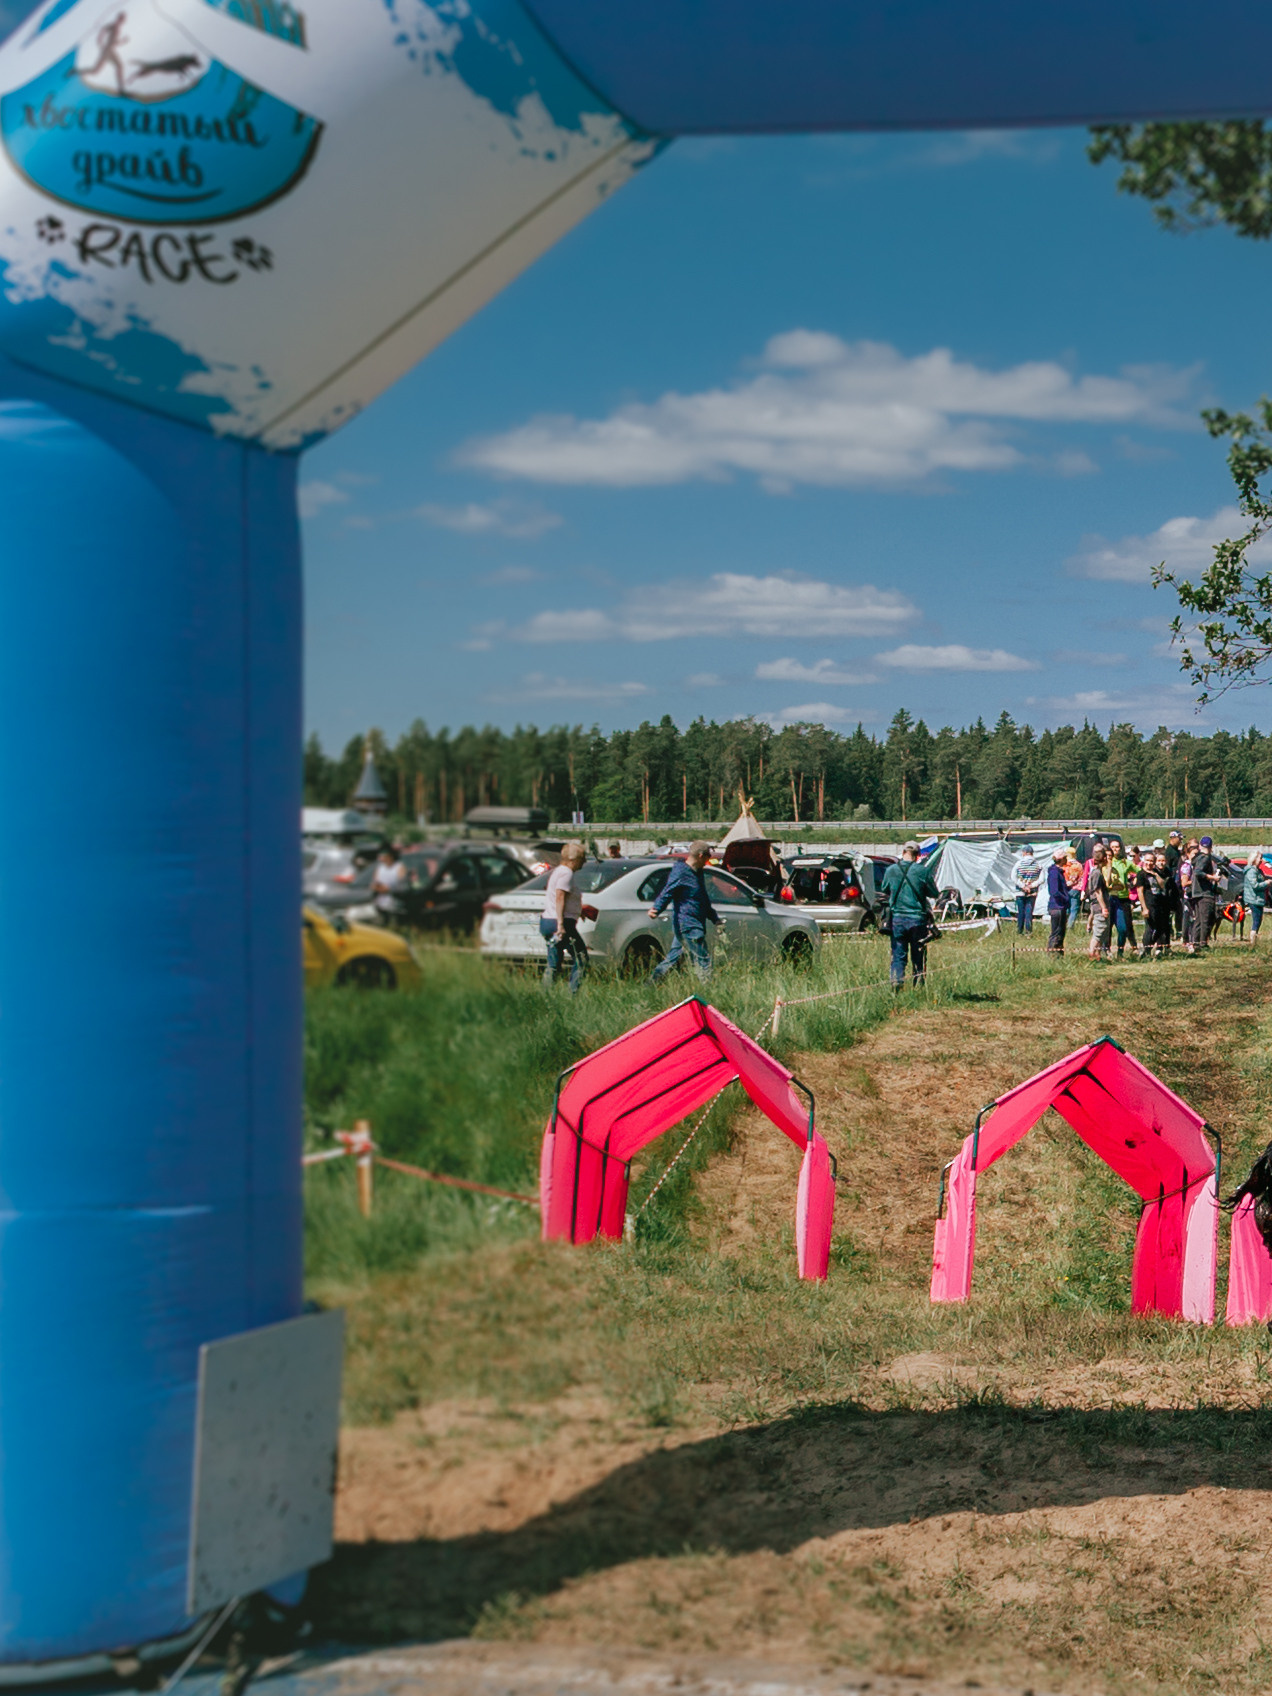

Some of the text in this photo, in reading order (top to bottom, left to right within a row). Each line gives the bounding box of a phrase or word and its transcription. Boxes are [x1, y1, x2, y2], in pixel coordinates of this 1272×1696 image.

[20, 91, 270, 148] хвостатый
[72, 144, 206, 195] драйв
[72, 223, 241, 285] RACE
